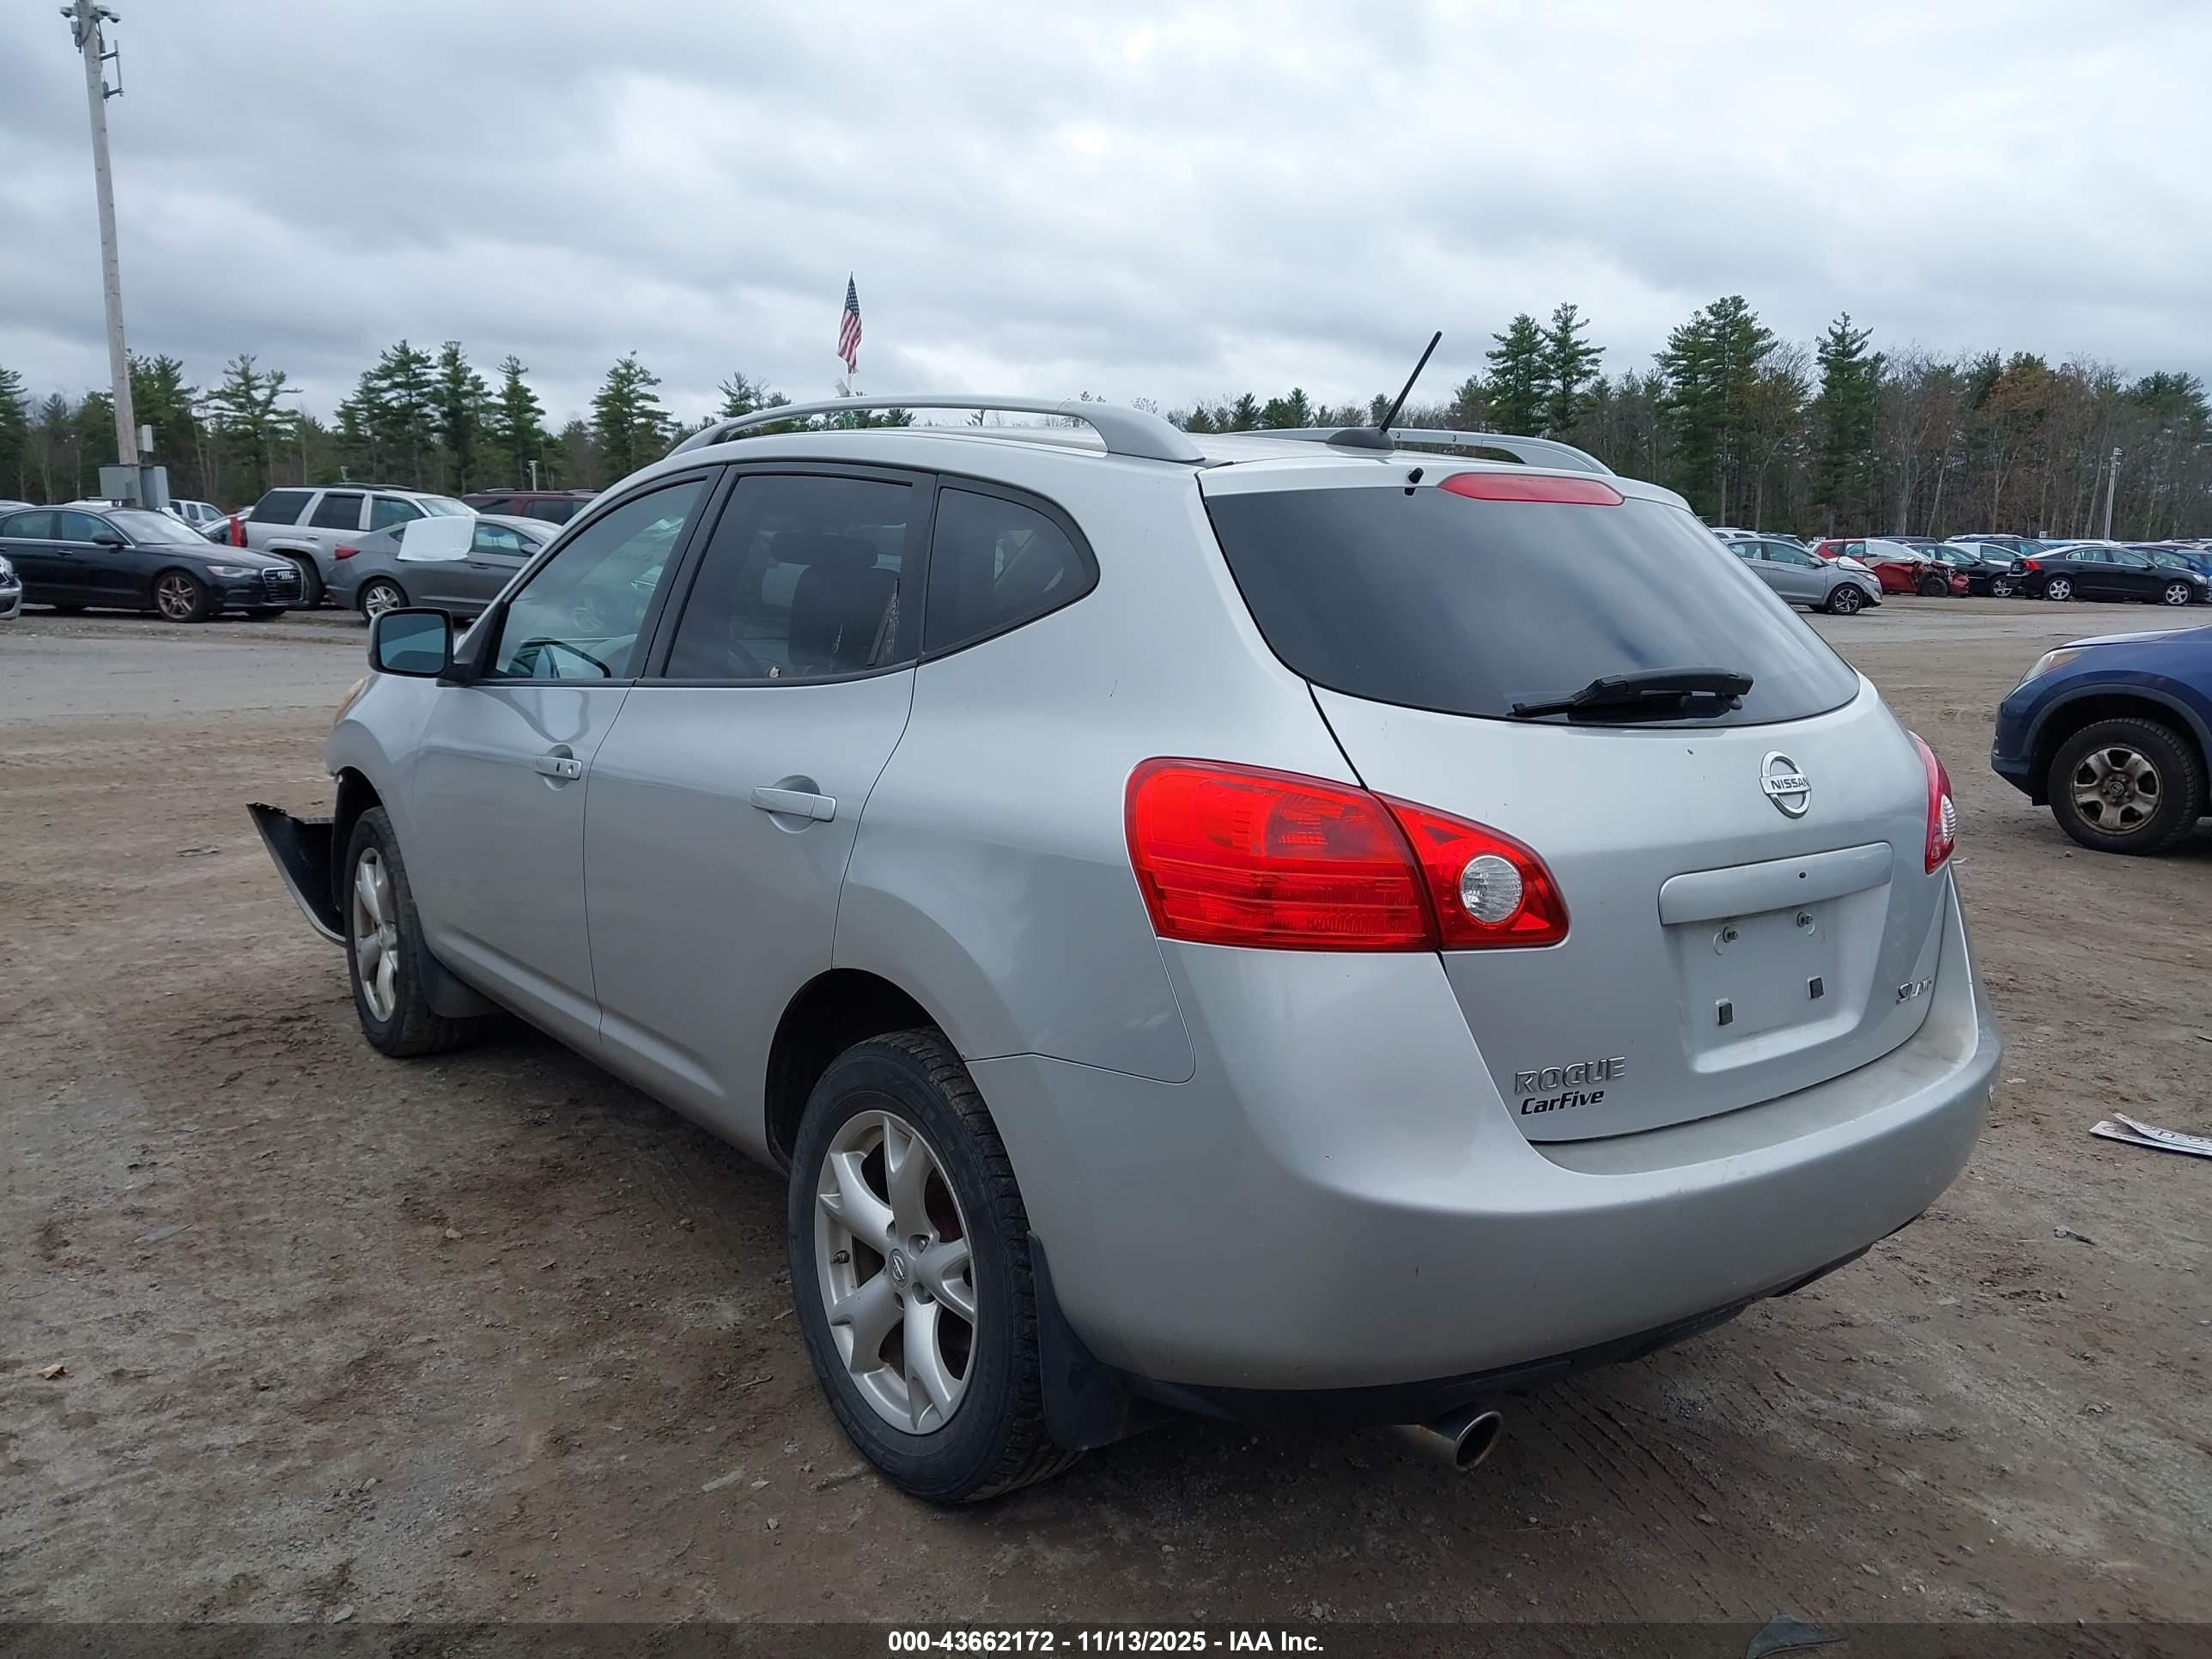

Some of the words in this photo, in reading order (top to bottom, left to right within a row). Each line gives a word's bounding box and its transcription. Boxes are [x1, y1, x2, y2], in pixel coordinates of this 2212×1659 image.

[1770, 776, 1810, 790] NISSAN
[1515, 1055, 1626, 1095] ROGUE
[1521, 1091, 1605, 1115] CarFive
